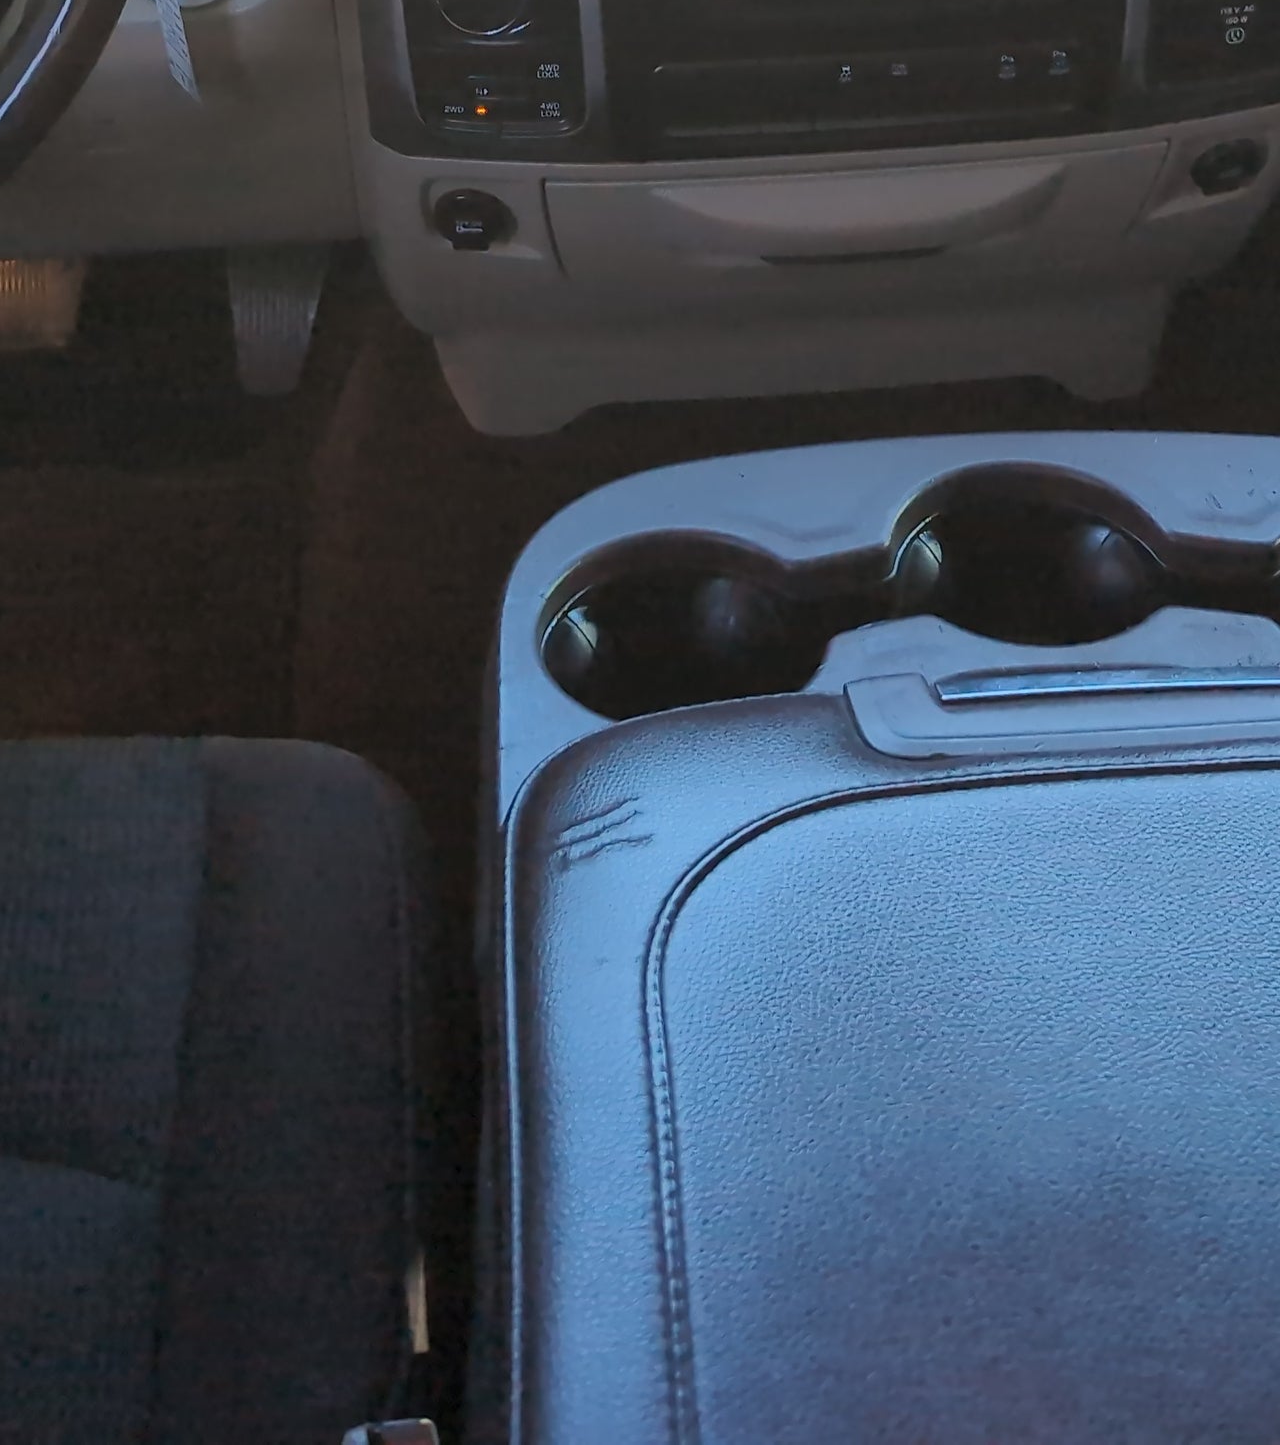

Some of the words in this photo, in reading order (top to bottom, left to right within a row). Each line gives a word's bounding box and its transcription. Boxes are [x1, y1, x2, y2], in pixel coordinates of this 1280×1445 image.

[539, 63, 560, 71] 4WD
[536, 71, 560, 79] LOCK
[444, 105, 464, 114] 2WD
[539, 102, 560, 110] 4WD
[540, 109, 560, 118] LOW
